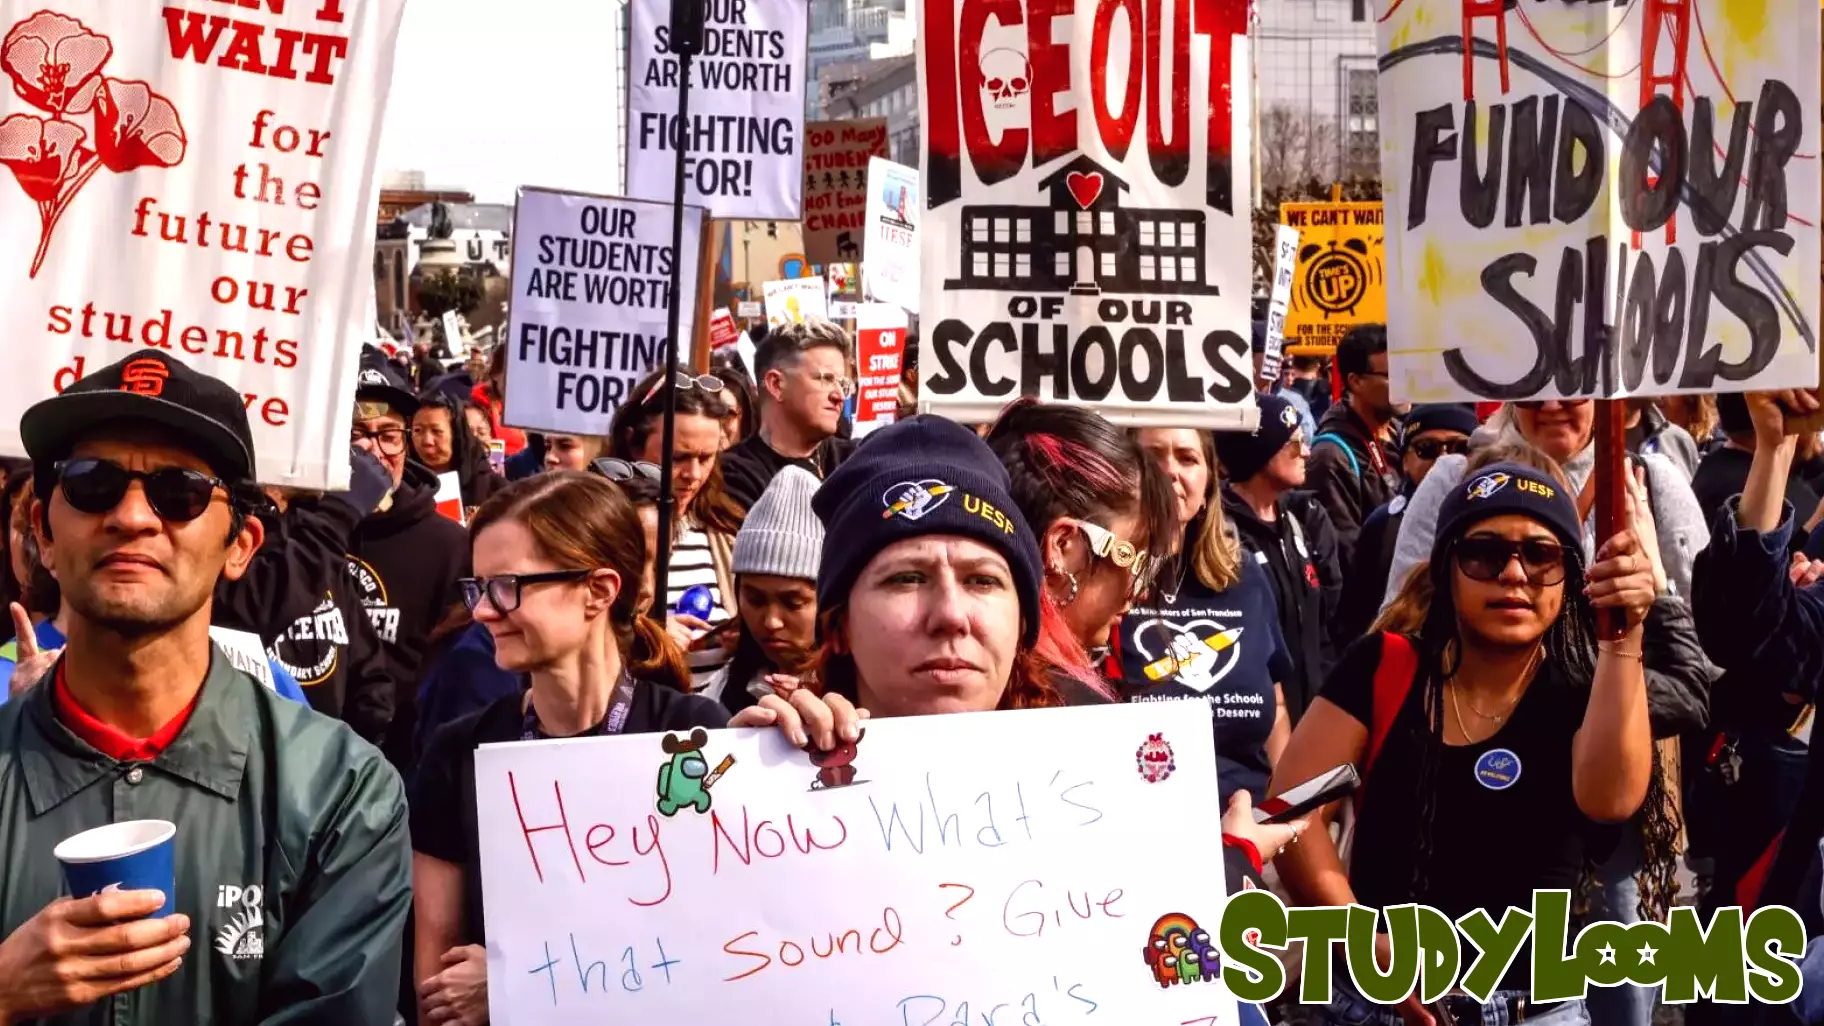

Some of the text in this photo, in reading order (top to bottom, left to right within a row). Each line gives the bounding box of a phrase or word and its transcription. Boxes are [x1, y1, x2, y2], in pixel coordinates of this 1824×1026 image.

[162, 7, 348, 85] WAIT
[654, 25, 784, 59] SDENTS
[700, 61, 791, 92] WORTH
[924, 0, 1249, 217] ICE OUT
[249, 109, 331, 158] for
[640, 112, 793, 155] FIGHTING
[682, 158, 753, 196] FOR!
[1408, 80, 1803, 236] FUND OUR
[233, 162, 321, 210] the
[131, 197, 314, 263] future
[580, 205, 636, 239] OUR
[1287, 209, 1307, 227] WE
[1311, 209, 1348, 226] CAN'T
[538, 234, 673, 276] STUDENTS
[211, 274, 308, 315] our
[526, 268, 577, 301] ARE
[1320, 274, 1355, 302] UP
[1008, 297, 1192, 325] OF OUR
[1297, 324, 1313, 334] FOR
[1317, 324, 1332, 334] THE
[1442, 230, 1795, 399] SCHOOLS
[47, 301, 298, 368] students
[879, 331, 896, 347] ON
[925, 319, 1255, 403] SCHOOLS
[1517, 478, 1555, 499] UESF
[962, 493, 1015, 535] UESF
[1217, 708, 1260, 718] Deserve
[1223, 693, 1264, 704] Schools
[508, 770, 1103, 906] Hey Now What's
[217, 884, 263, 908] iPO
[528, 932, 681, 1006] that
[938, 883, 975, 946] ?
[1004, 879, 1126, 937] Give
